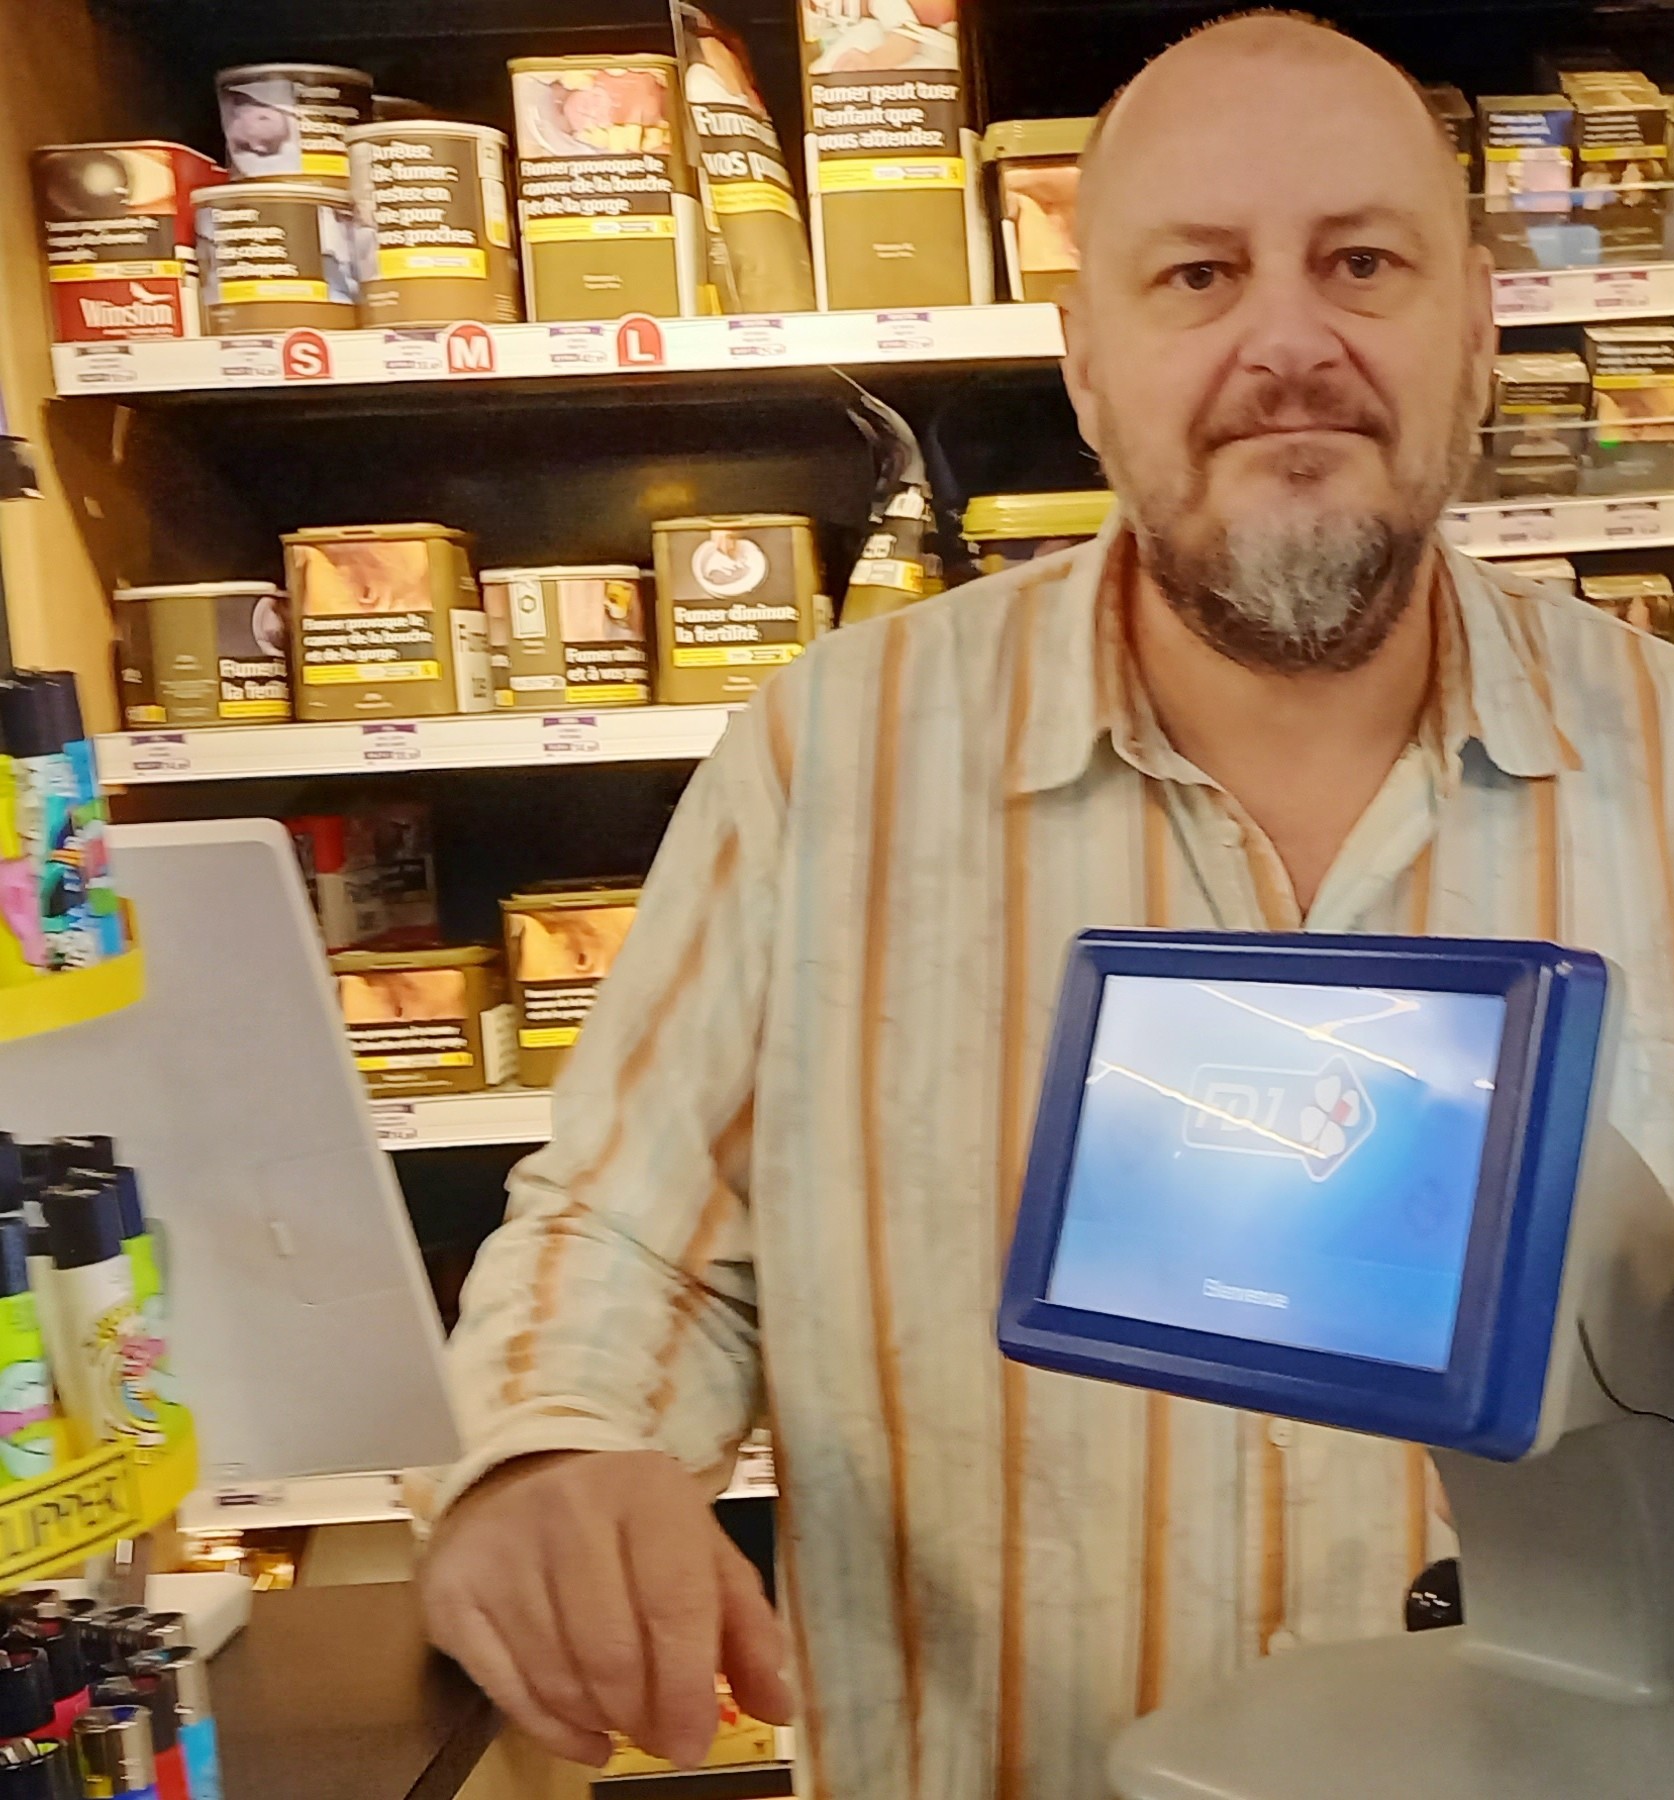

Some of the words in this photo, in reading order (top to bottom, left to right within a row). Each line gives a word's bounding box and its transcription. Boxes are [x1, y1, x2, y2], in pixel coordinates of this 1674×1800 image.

[79, 298, 174, 328] Winston
[290, 342, 322, 376] S
[449, 336, 489, 370] M
[626, 327, 656, 362] L
